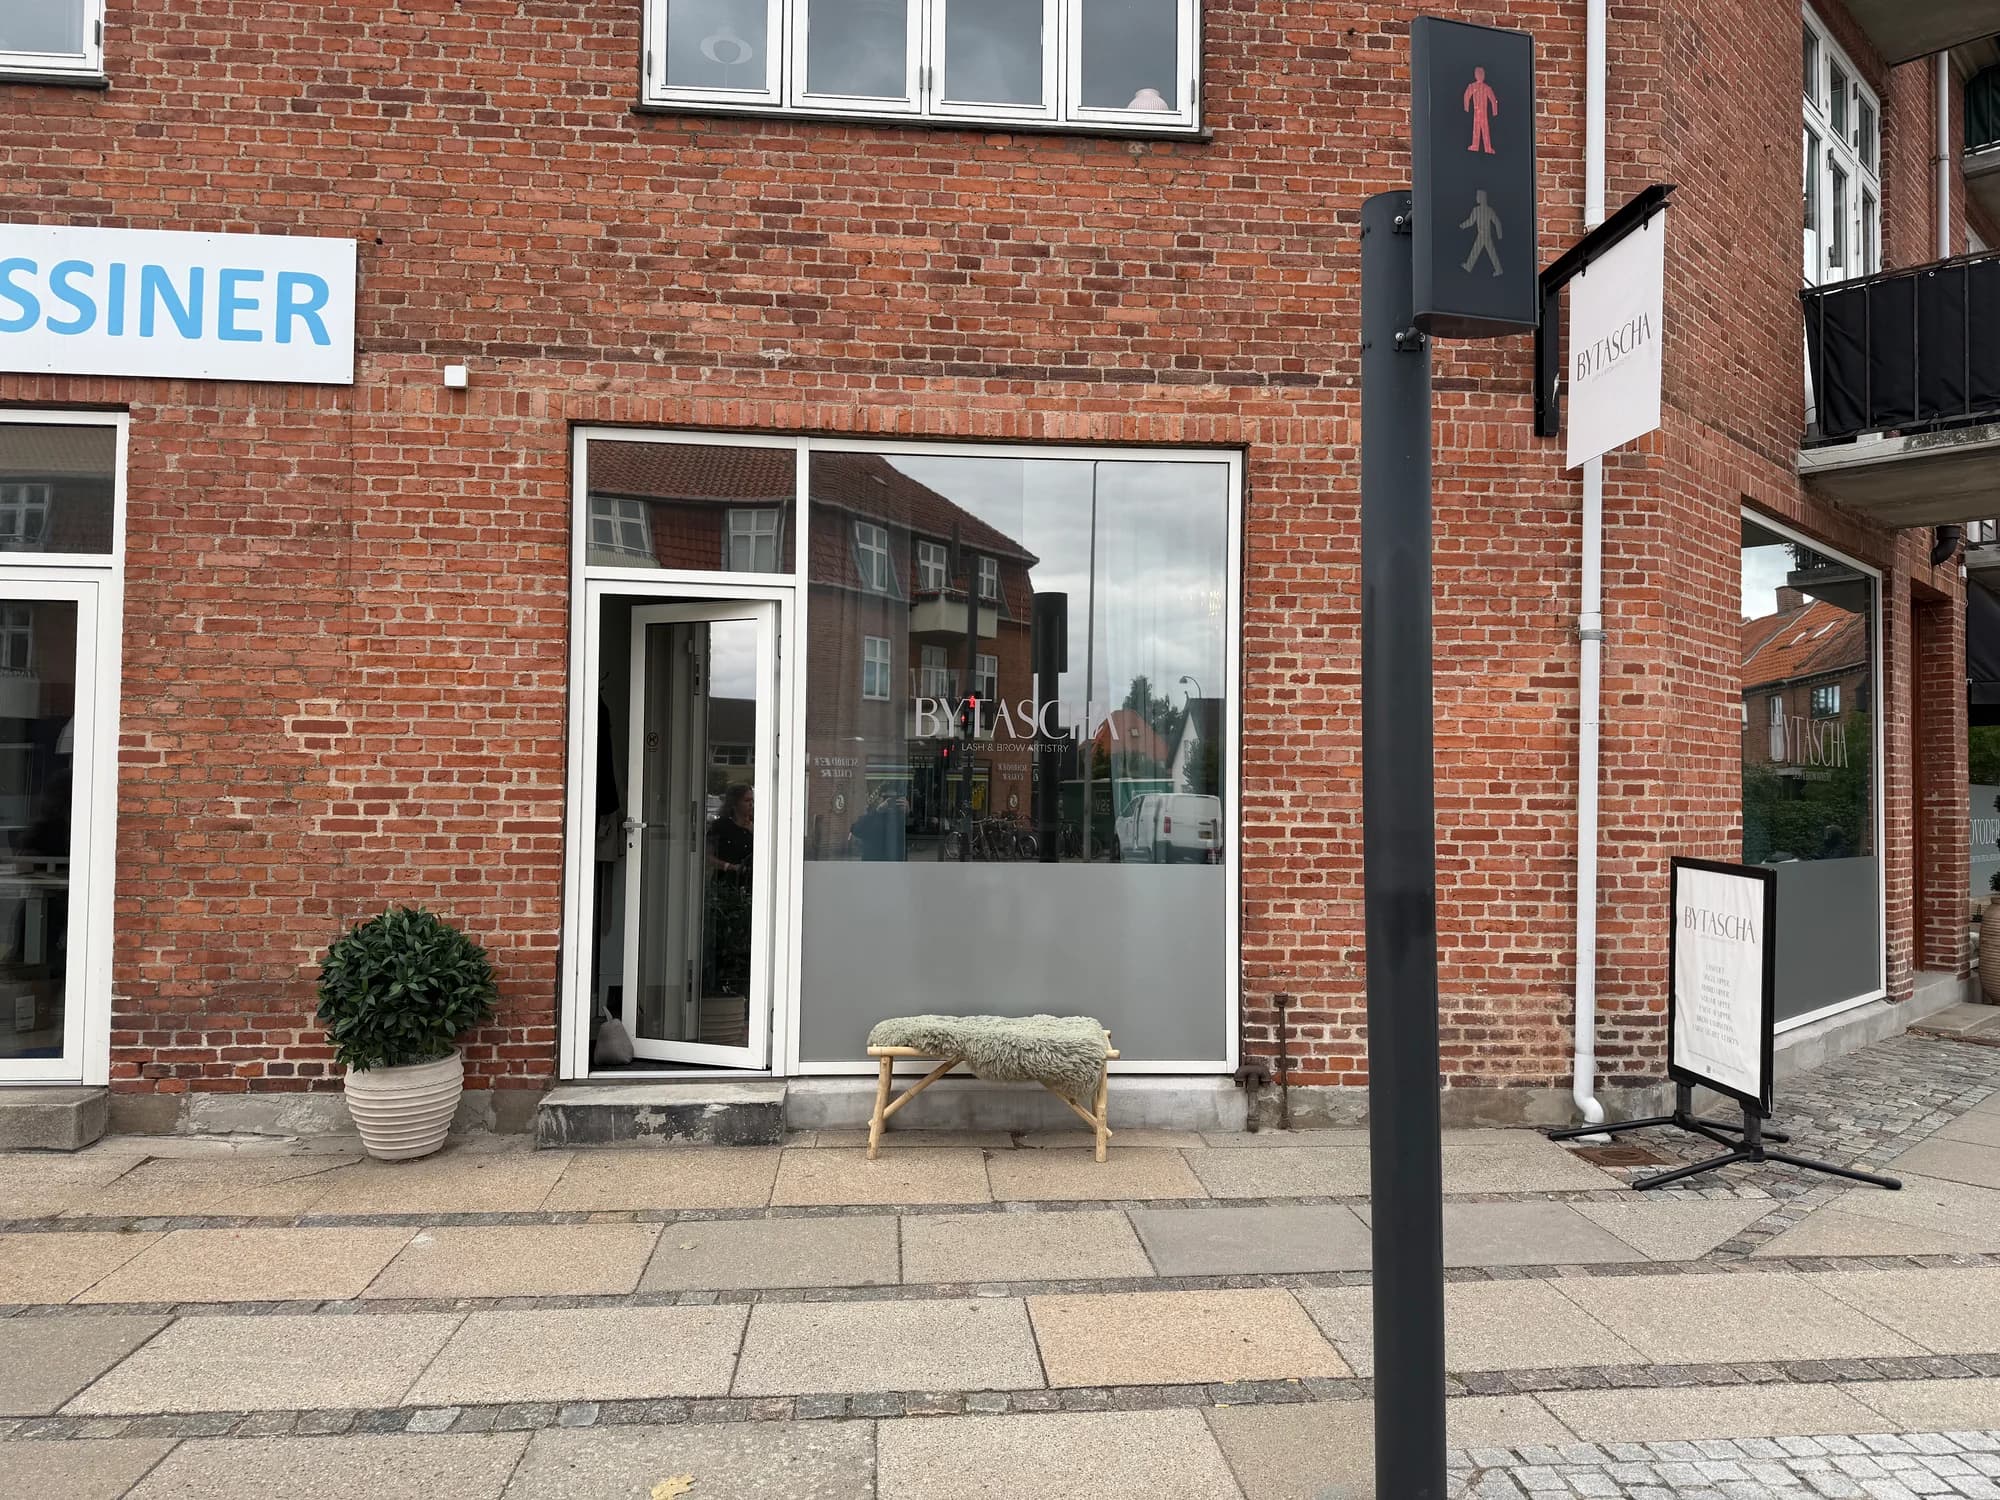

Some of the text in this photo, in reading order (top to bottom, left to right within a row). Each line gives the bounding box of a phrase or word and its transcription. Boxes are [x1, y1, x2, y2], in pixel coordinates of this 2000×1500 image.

[0, 257, 331, 346] SSINER
[1577, 312, 1651, 382] BYTASCHA
[914, 696, 1120, 740] BYTASCHA
[961, 743, 1070, 753] LASH & BROW ARTISTRY
[1685, 906, 1755, 944] BYTASCHA
